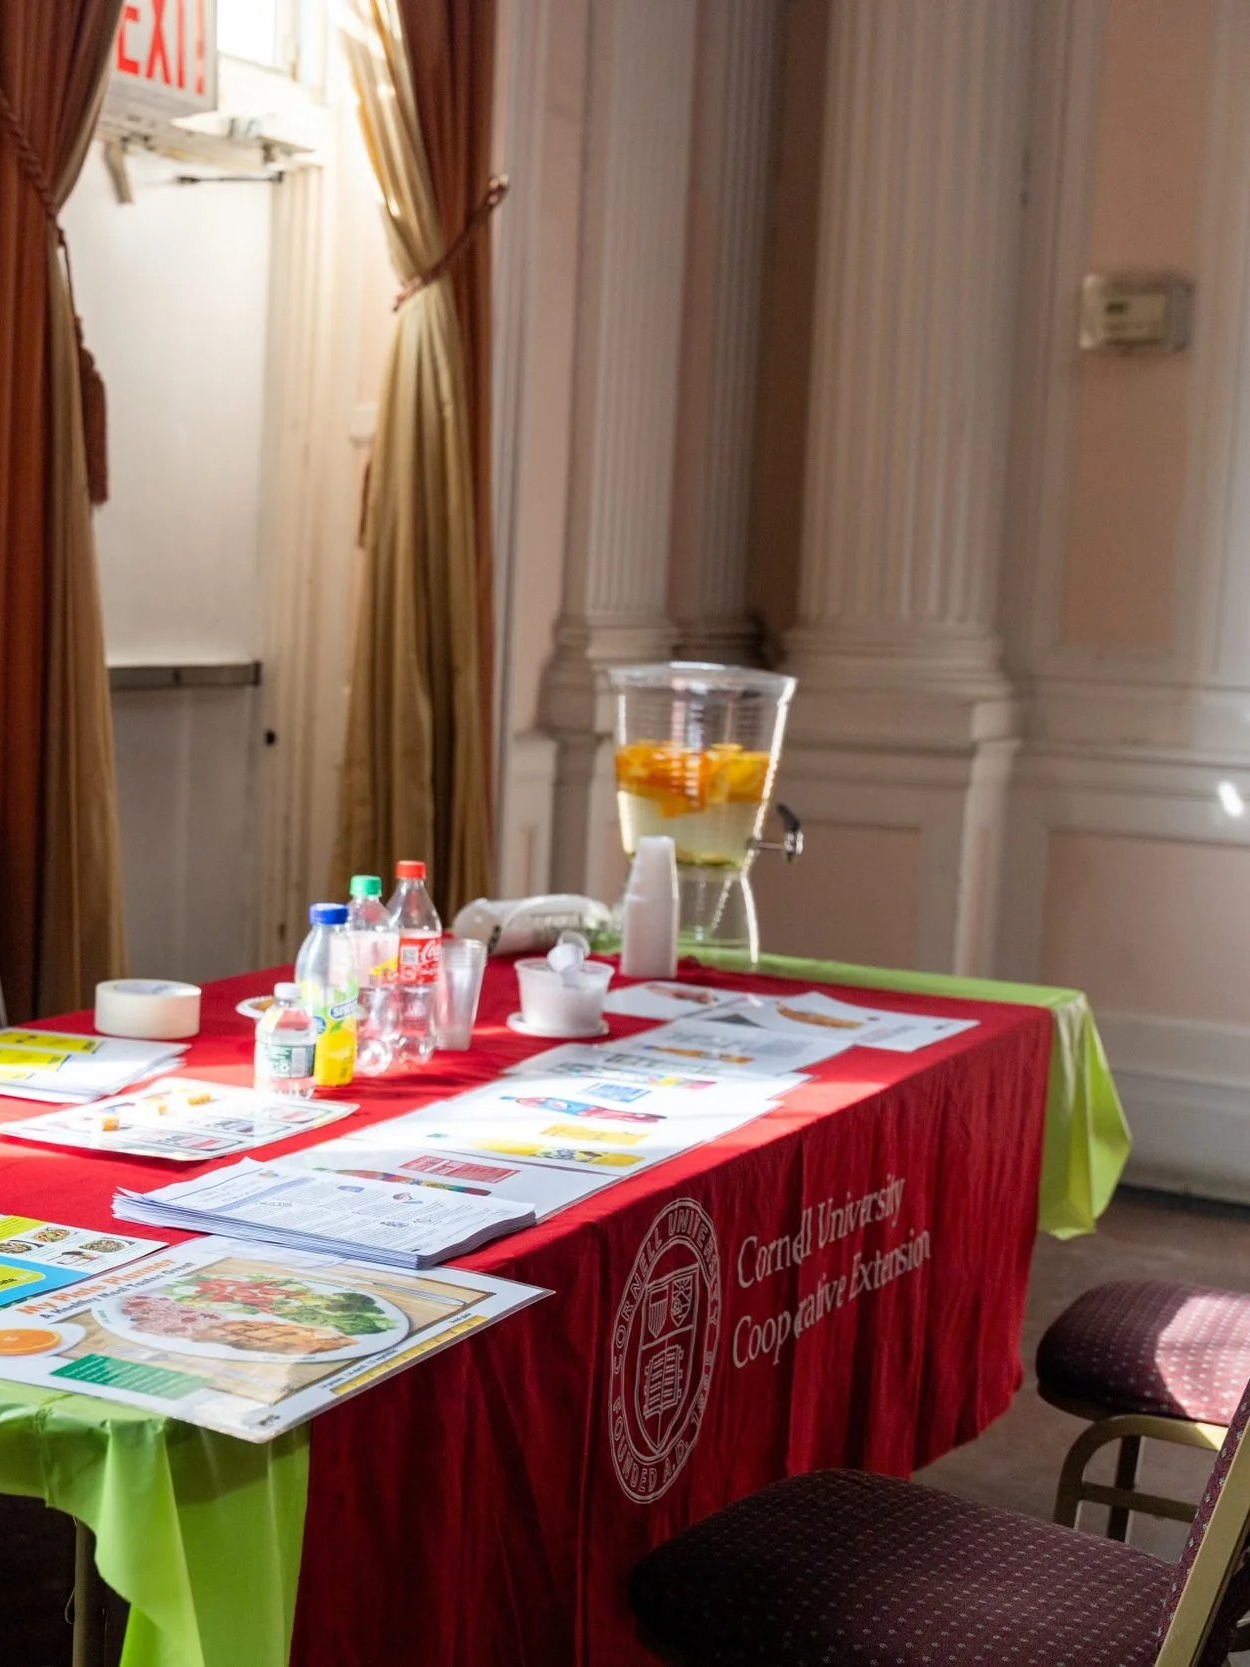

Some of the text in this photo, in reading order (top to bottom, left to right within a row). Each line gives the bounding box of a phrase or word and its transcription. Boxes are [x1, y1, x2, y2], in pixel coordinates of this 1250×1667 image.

[737, 1173, 906, 1289] Cornell University
[15, 1259, 175, 1315] My Plate Planner
[39, 1312, 51, 1320] A
[53, 1297, 100, 1315] Healthy
[97, 1288, 128, 1300] Meal
[732, 1228, 932, 1370] Cooperative Extension
